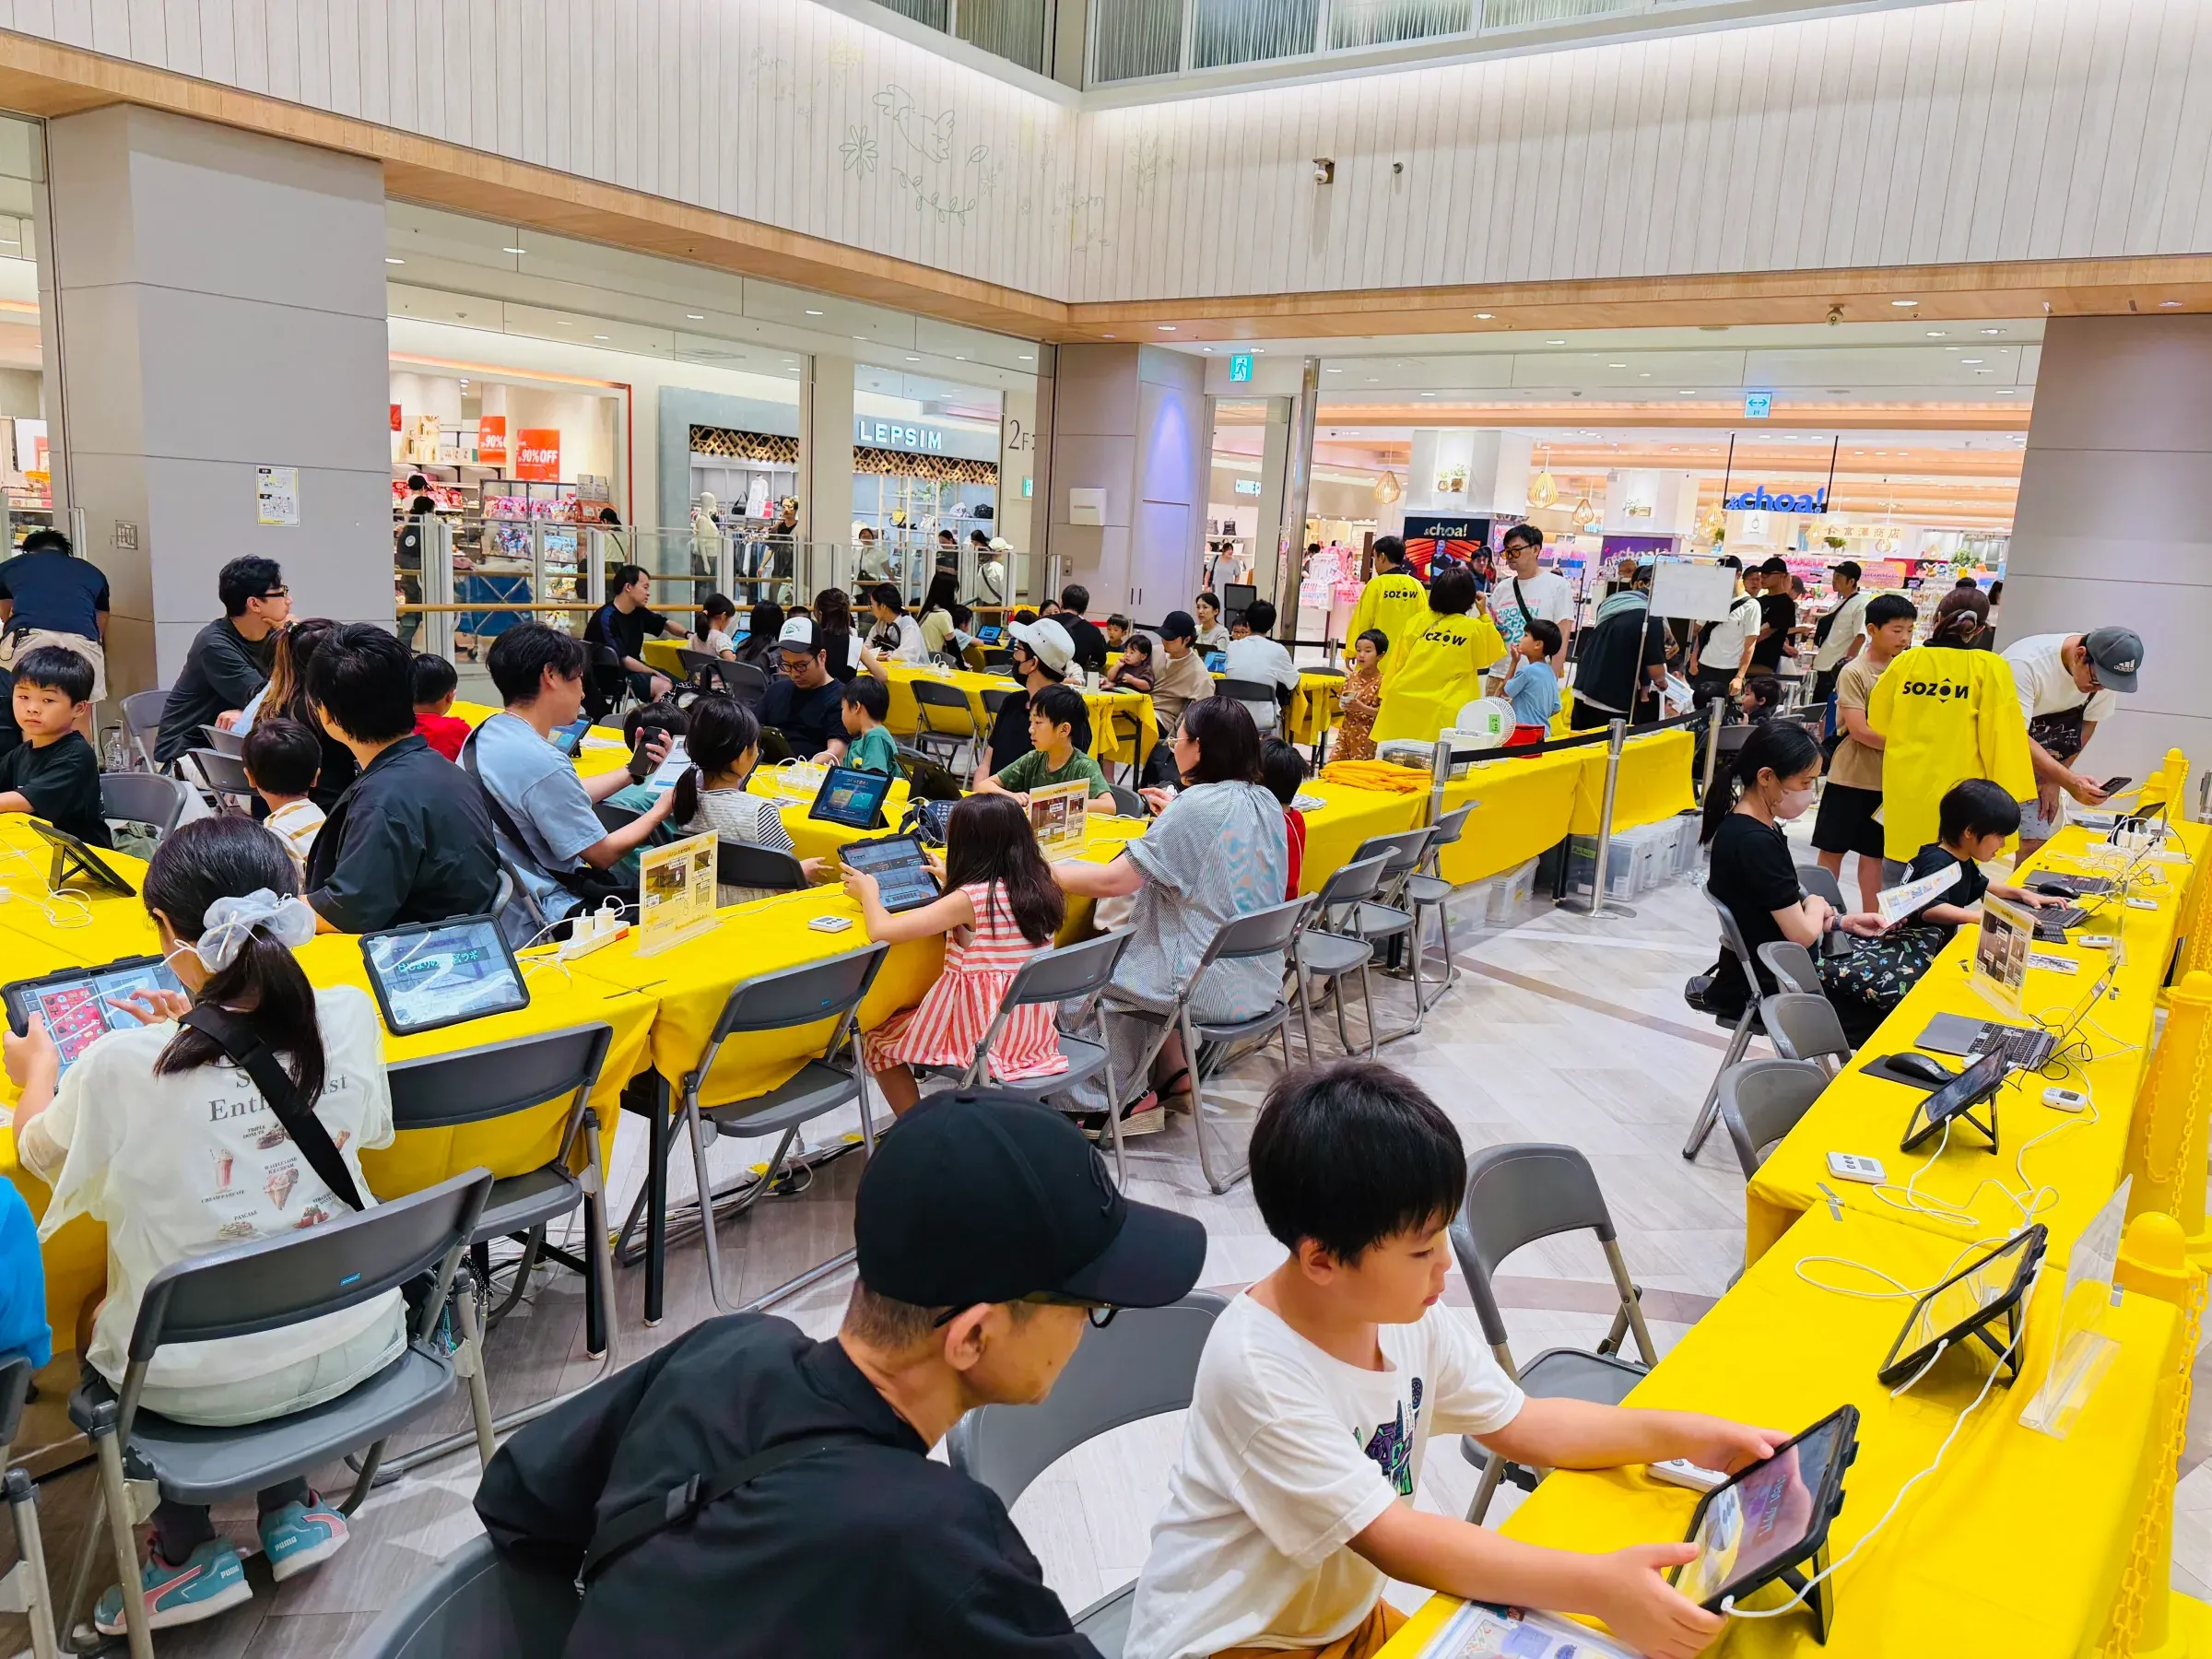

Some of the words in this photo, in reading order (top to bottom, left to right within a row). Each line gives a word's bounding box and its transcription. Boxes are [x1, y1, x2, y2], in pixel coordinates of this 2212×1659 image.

[859, 420, 942, 450] LEPSIM
[1725, 485, 1826, 513] &choa!
[1424, 523, 1468, 537] &choa!
